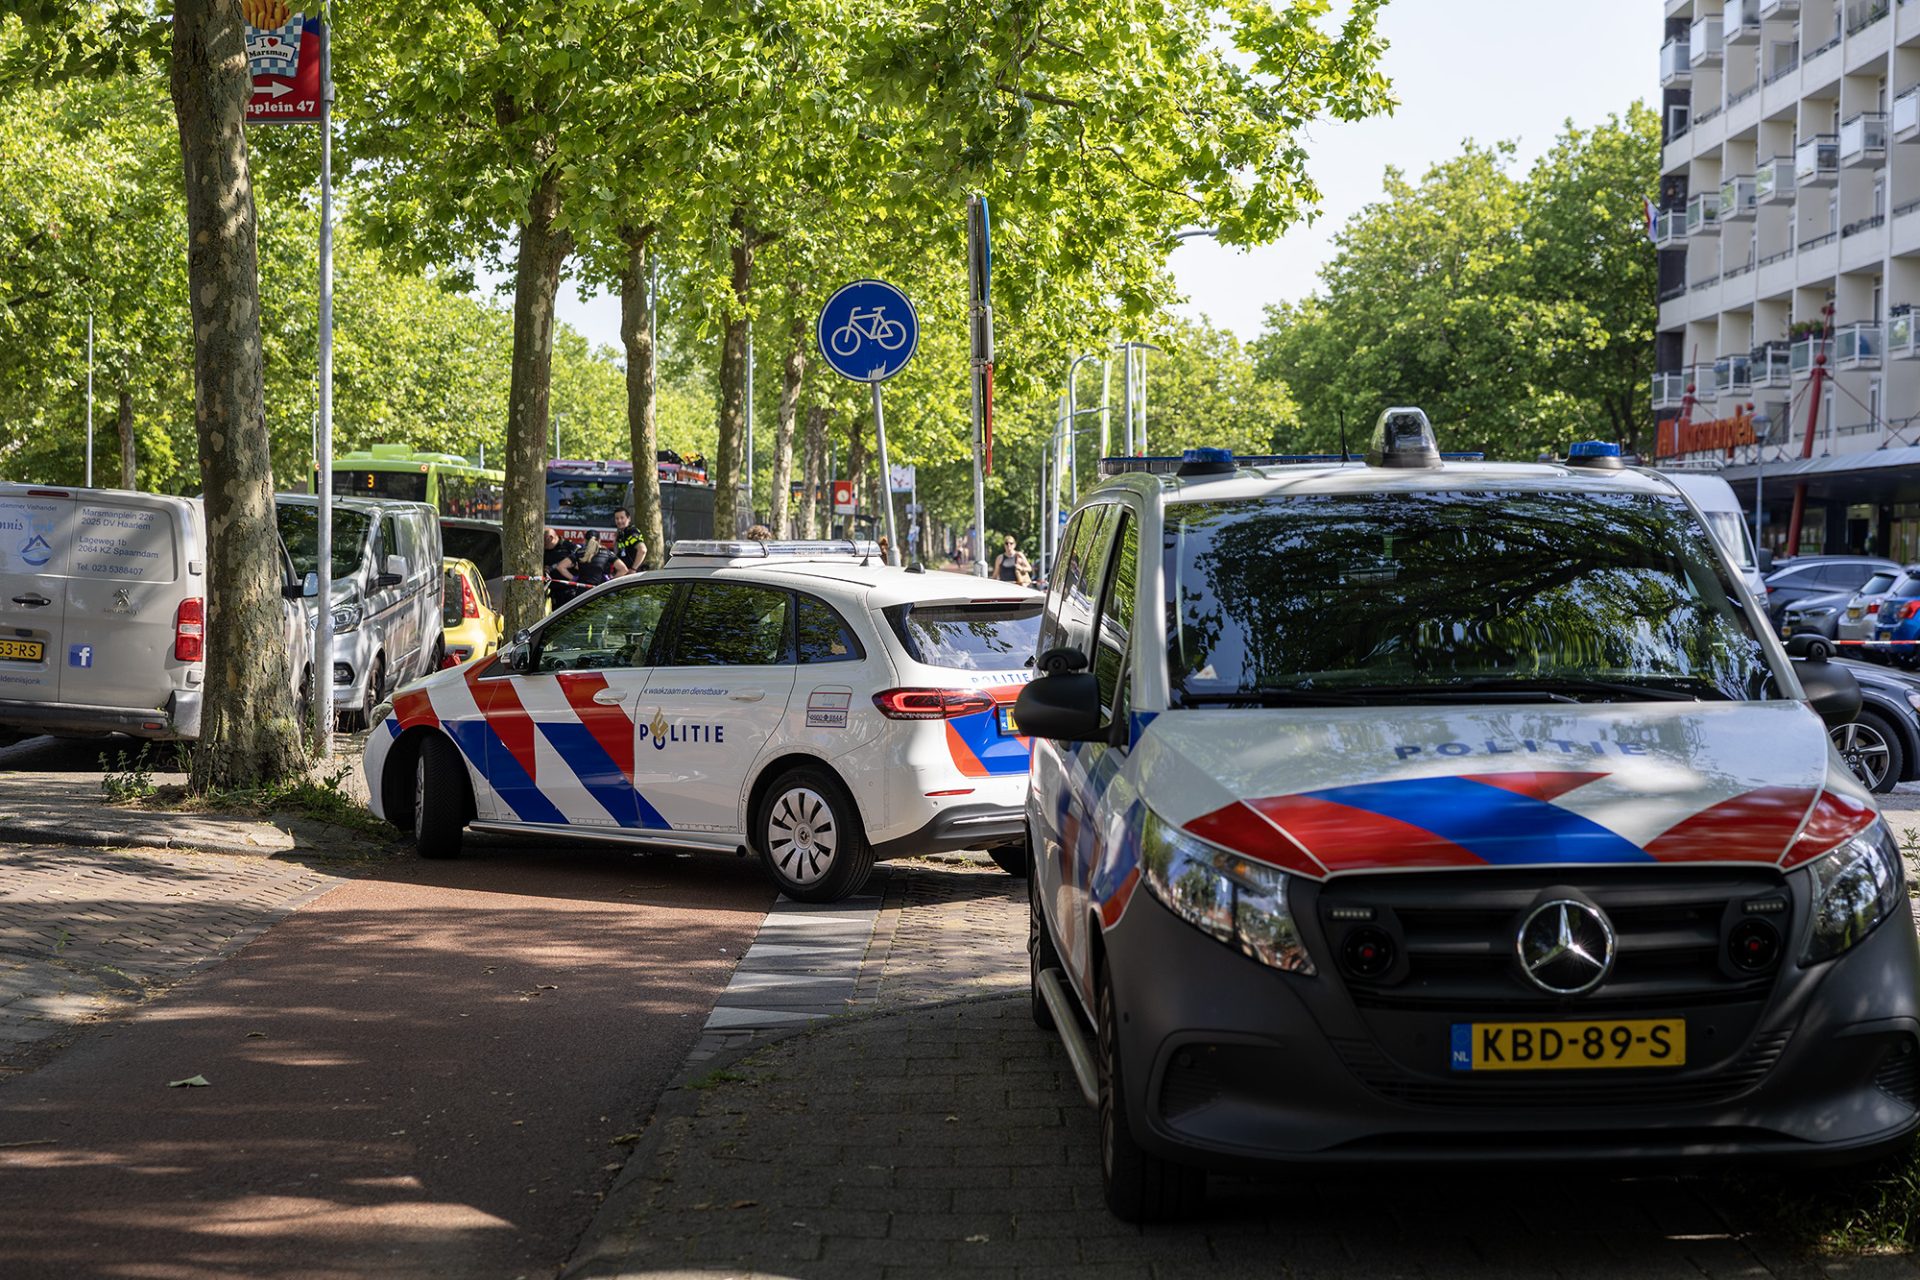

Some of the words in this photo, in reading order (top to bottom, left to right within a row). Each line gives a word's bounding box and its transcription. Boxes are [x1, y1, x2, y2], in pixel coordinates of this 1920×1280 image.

[260, 38, 266, 48] I
[249, 50, 288, 58] Marsman
[297, 100, 315, 112] 47
[367, 473, 375, 488] 3
[27, 503, 57, 512] Vishandel
[82, 508, 137, 520] Marsmanplein
[81, 517, 101, 526] 2025
[103, 519, 116, 527] DV
[117, 520, 151, 531] Haarlem
[79, 535, 115, 547] Lageweg
[78, 545, 98, 553] 2064
[113, 547, 159, 559] Spaarndam
[91, 563, 107, 573] 023
[971, 673, 1031, 684] POLITIE
[639, 723, 724, 750] POLITIE
[1394, 740, 1648, 760] POLITIE
[1453, 1052, 1470, 1062] NL
[1483, 1025, 1671, 1062] KBD-89-S
